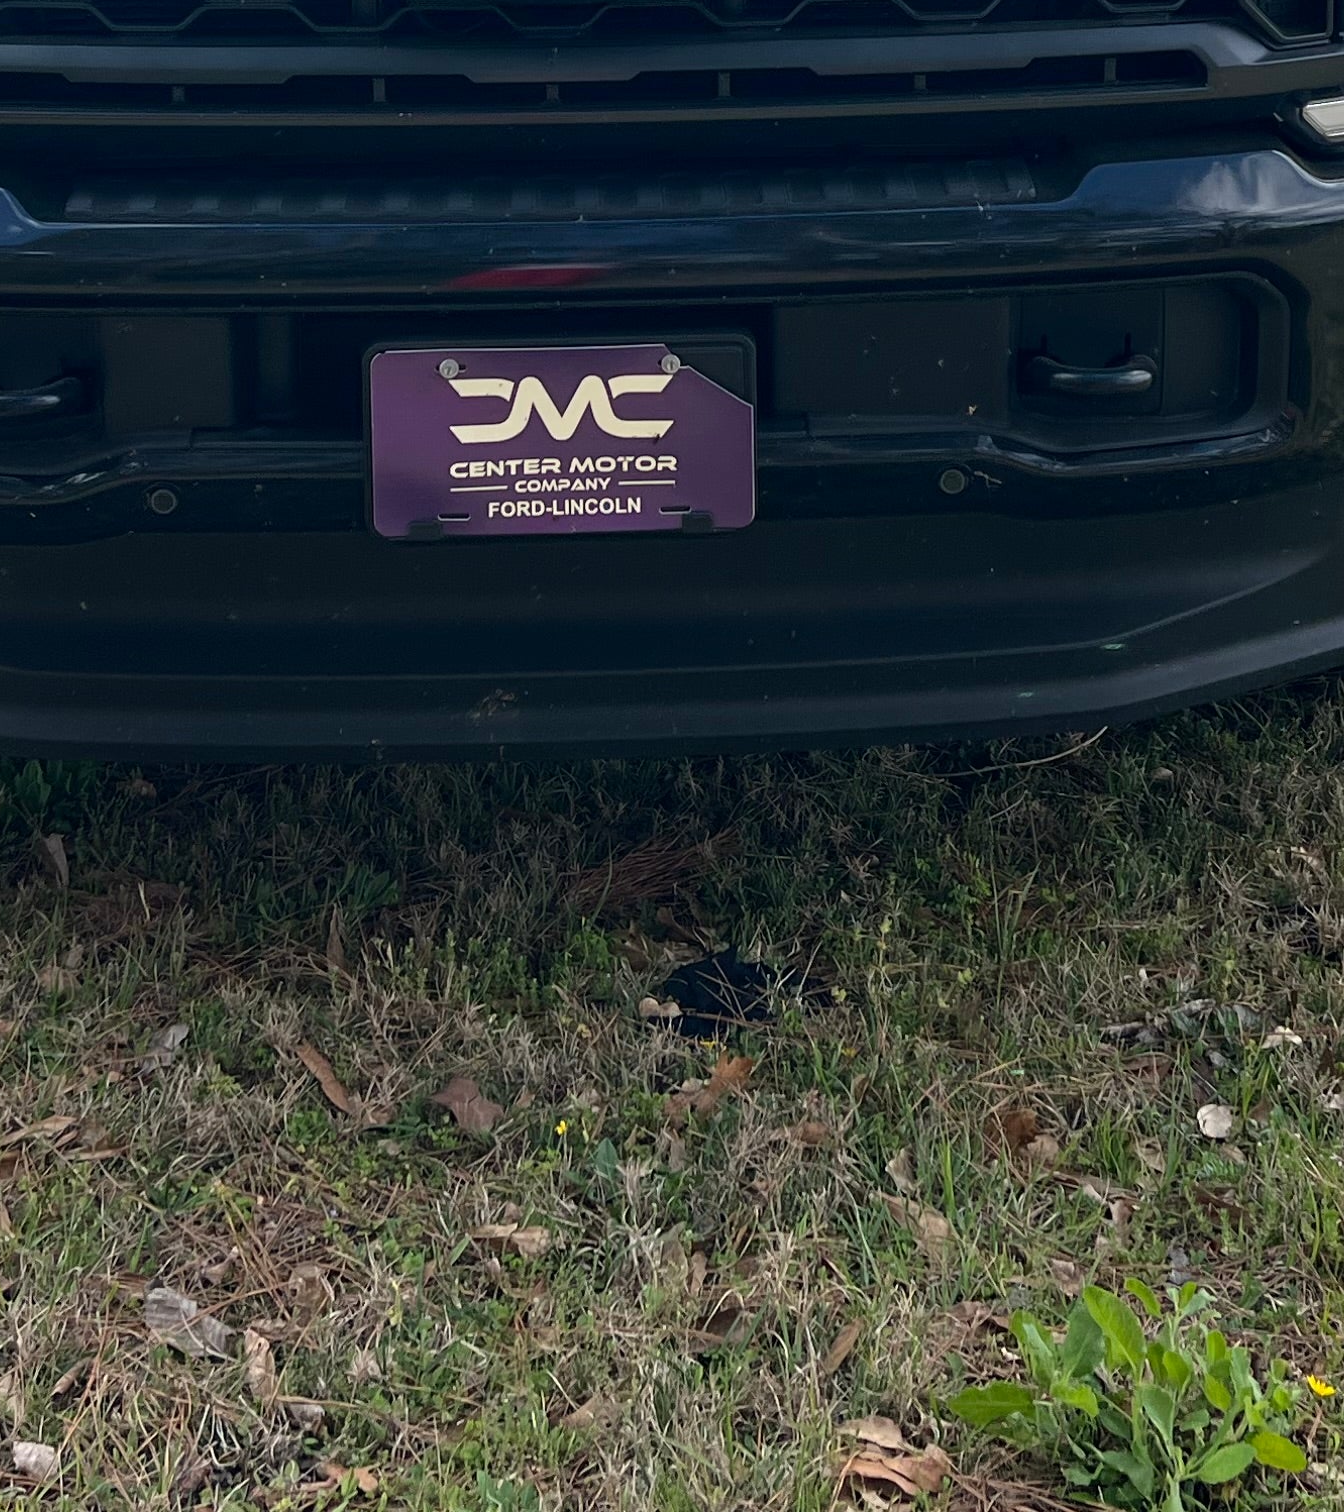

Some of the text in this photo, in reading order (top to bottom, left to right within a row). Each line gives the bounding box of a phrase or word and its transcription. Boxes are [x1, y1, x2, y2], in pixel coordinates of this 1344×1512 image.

[449, 454, 678, 479] CENTER MOTOR
[514, 476, 613, 494] COMPANY
[487, 496, 642, 519] FORD-LINCOLN
